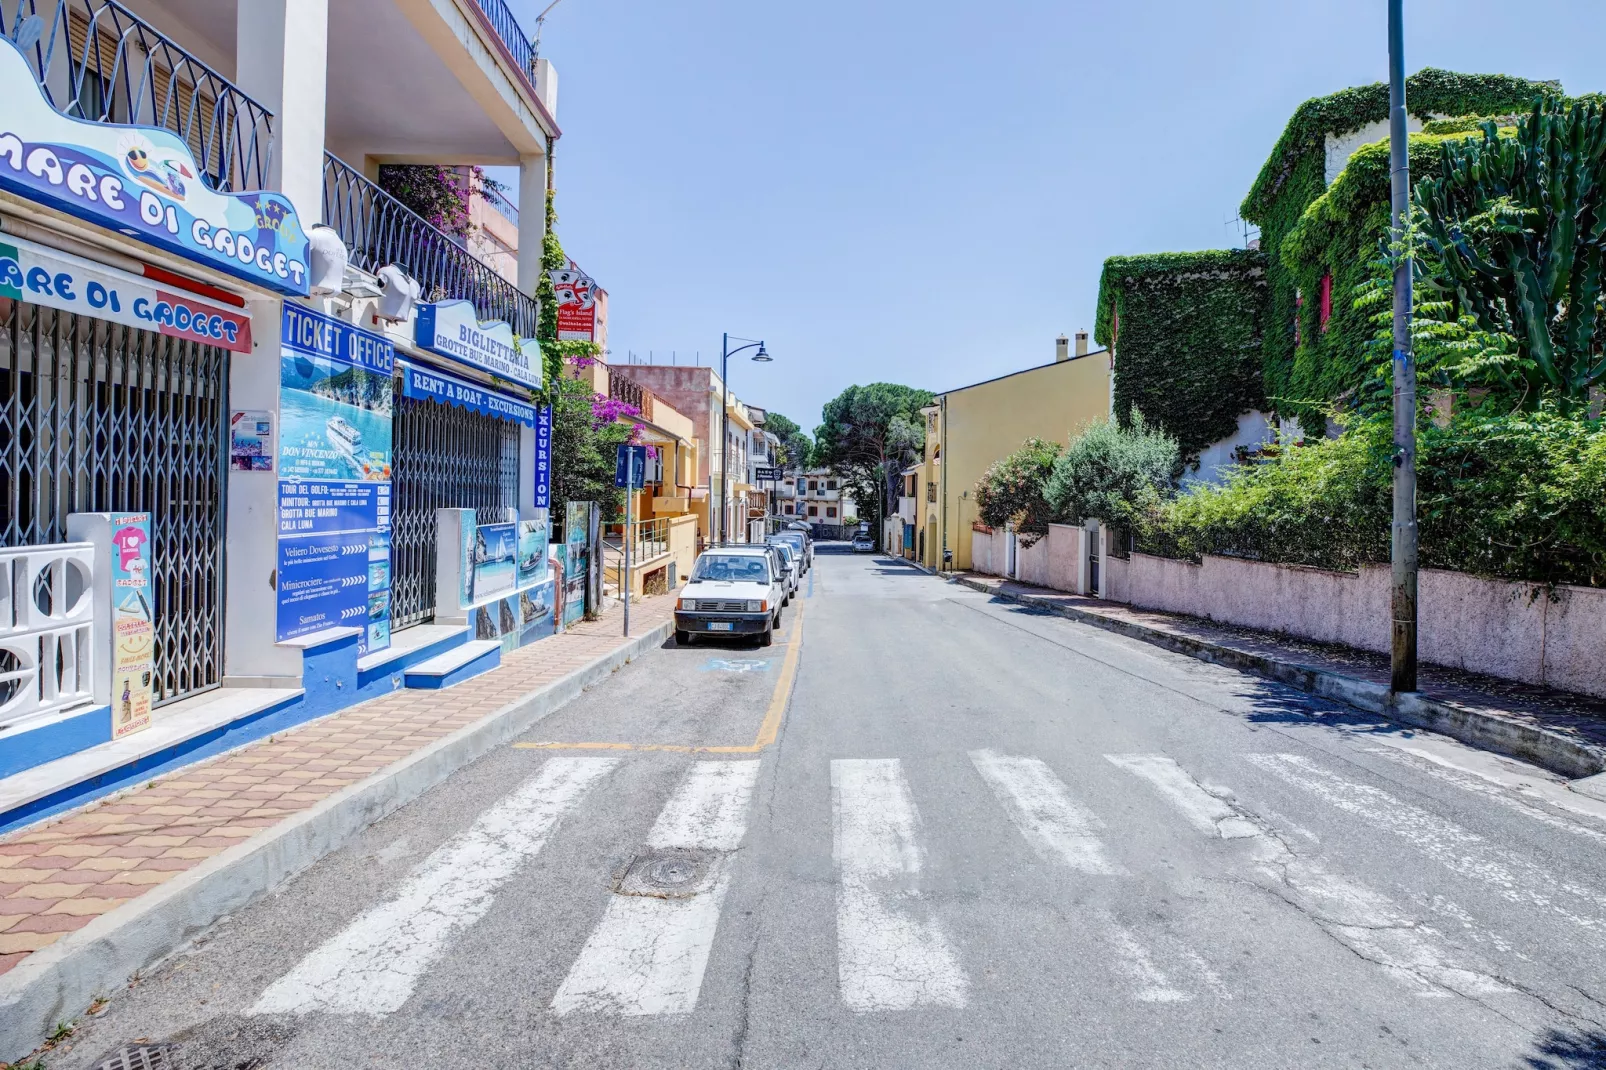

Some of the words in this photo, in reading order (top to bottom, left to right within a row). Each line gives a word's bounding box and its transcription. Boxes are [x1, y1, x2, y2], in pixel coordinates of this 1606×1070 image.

[141, 193, 178, 234] DI
[193, 220, 305, 284] GADGET
[87, 281, 121, 312] DI
[133, 298, 238, 342] GADGET
[286, 310, 342, 355] TICKET
[348, 333, 391, 370] OFFICE
[459, 324, 529, 370] BIGLIETTERIA
[436, 334, 468, 358] GROTTE
[469, 348, 483, 364] BUE
[484, 354, 510, 373] MARINO
[514, 365, 527, 381] CALA
[528, 373, 542, 385] LUNA
[413, 373, 445, 395] RENT
[446, 384, 455, 398] A
[456, 386, 482, 405] BOAT
[488, 397, 534, 420] EXCURSIONS
[282, 446, 300, 456] DON
[301, 448, 338, 459] VINCENZO
[281, 485, 297, 494] TOUR
[298, 485, 309, 494] DEL
[310, 485, 329, 494] GOLFO:
[281, 497, 310, 507] MINITOUR:
[281, 508, 302, 518] GROTTA
[304, 508, 316, 518] BUE
[317, 508, 338, 517] MARINO
[281, 520, 297, 530] CALA
[298, 520, 313, 529] LUNA
[285, 547, 308, 557] Veliero
[309, 545, 339, 555] Dovesesto
[281, 577, 323, 591] Minicrociere
[299, 612, 326, 625] Samatos
